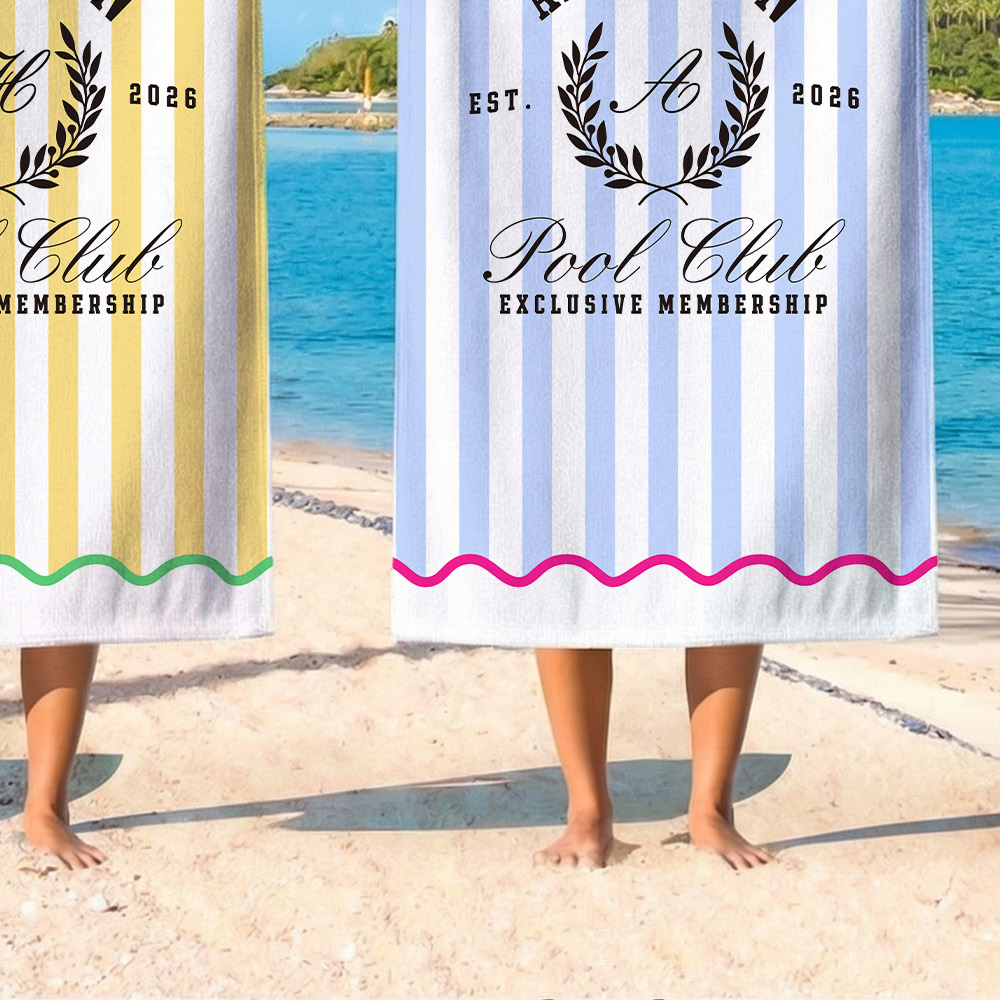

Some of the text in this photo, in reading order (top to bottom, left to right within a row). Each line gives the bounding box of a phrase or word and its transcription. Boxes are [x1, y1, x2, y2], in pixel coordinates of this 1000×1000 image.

[609, 47, 704, 115] A
[130, 82, 196, 110] 2026
[470, 88, 532, 115] EST.
[792, 82, 860, 110] 2026
[18, 216, 184, 284] Club
[484, 216, 846, 284] Pool Club
[500, 294, 828, 315] EXCLUSIVE MEMBERSHIP
